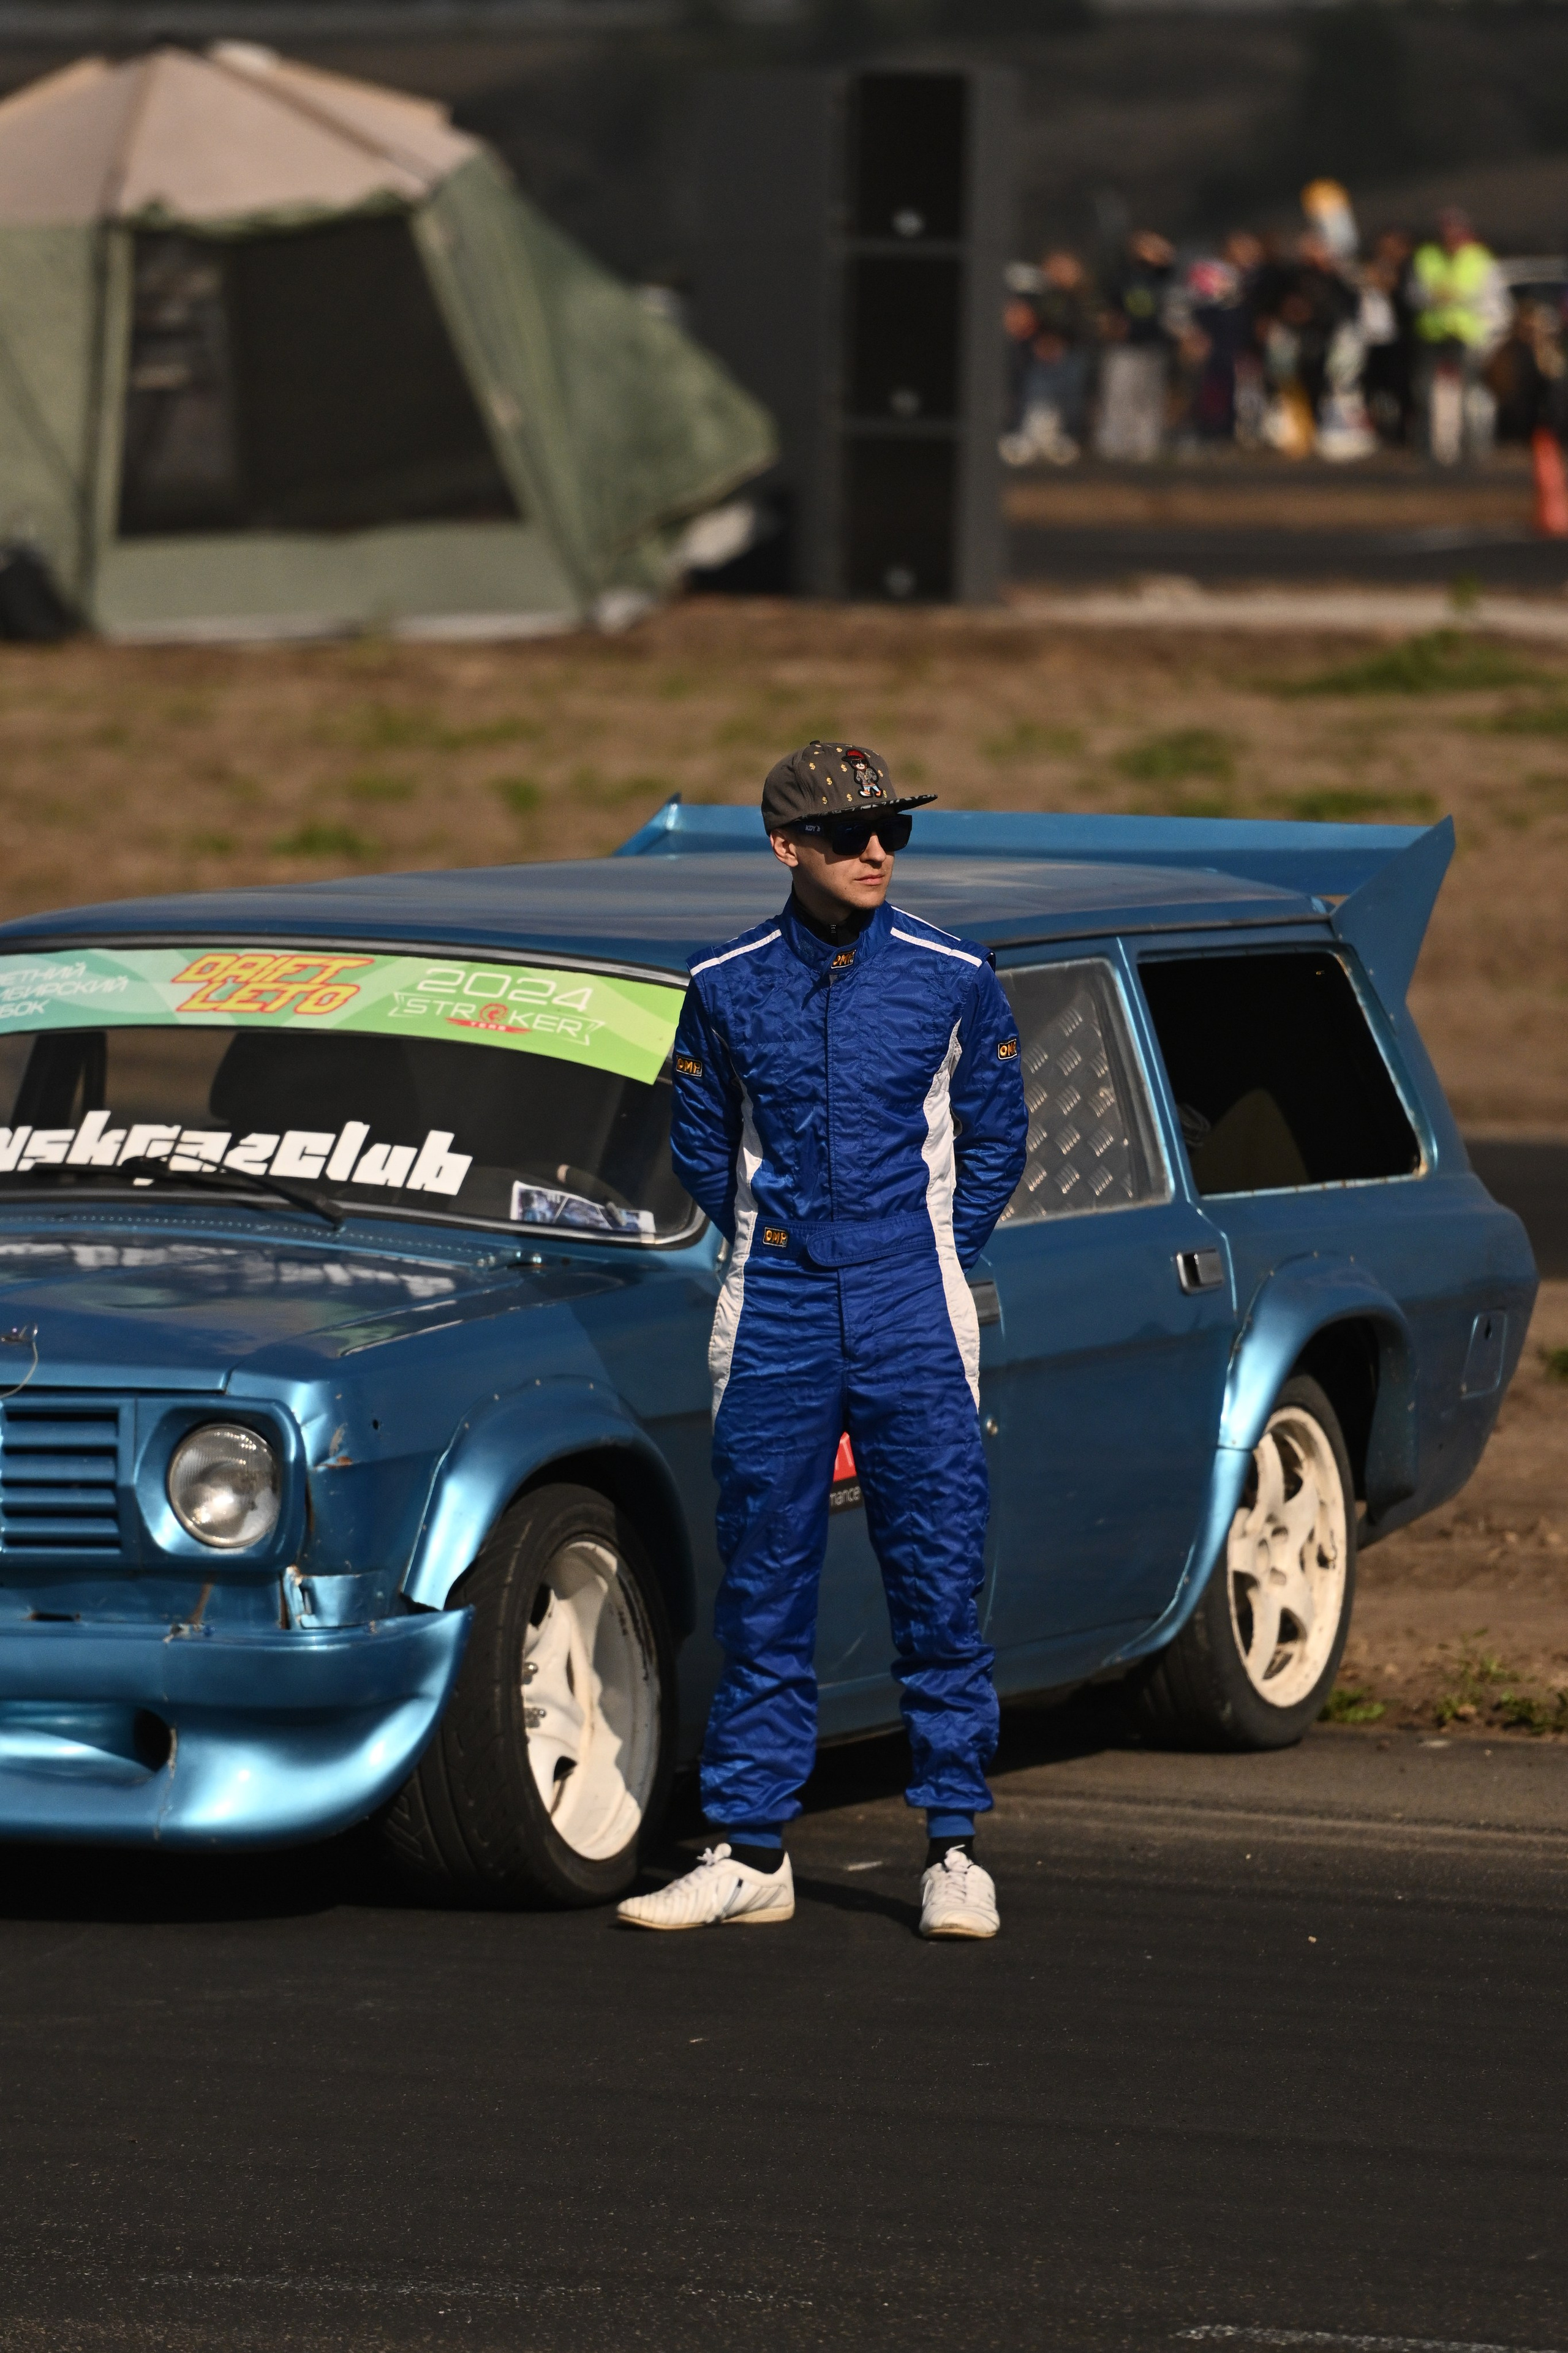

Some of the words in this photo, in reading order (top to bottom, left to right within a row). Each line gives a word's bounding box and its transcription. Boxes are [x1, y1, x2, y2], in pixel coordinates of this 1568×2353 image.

[0, 962, 86, 987] ЕТНИЙ
[172, 954, 375, 984] DRIFT
[176, 981, 361, 1015] LETO
[417, 968, 593, 1012] 2024
[0, 999, 51, 1019] БОК
[677, 1058, 701, 1074] OMP
[766, 1230, 786, 1244] OMP
